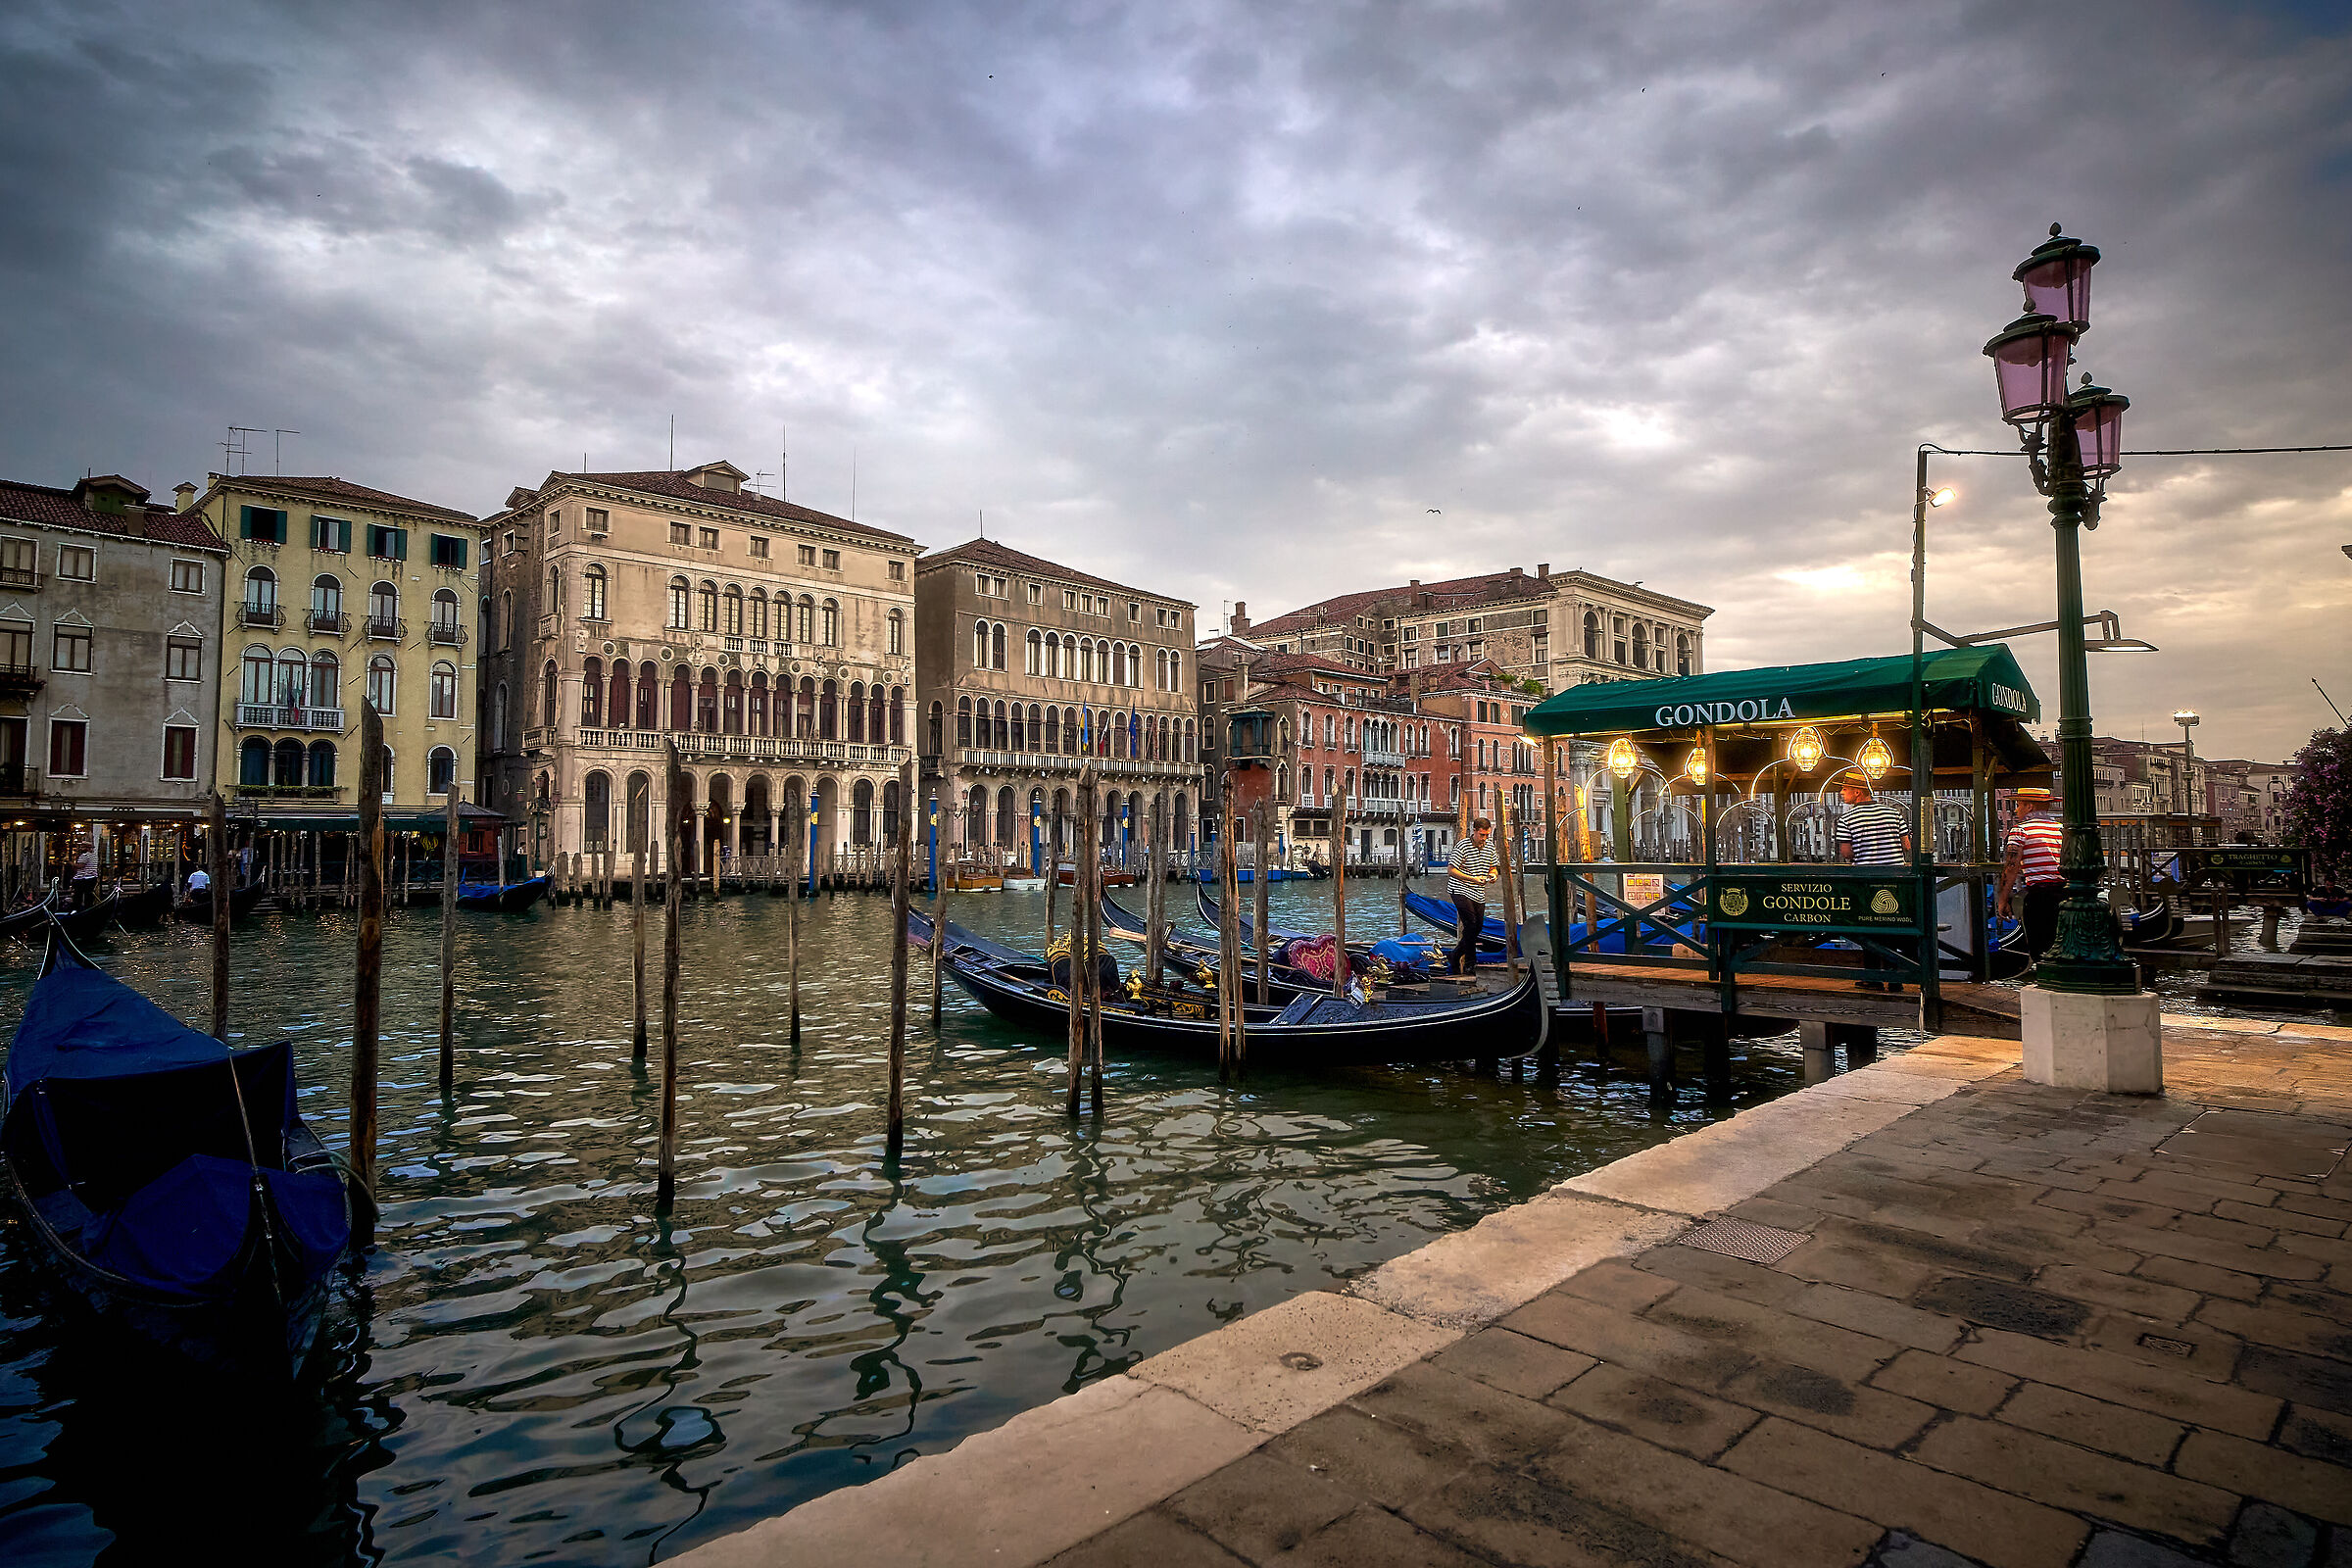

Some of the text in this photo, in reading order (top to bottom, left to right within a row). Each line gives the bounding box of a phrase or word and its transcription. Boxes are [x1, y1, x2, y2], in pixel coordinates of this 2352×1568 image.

[1991, 682, 2027, 713] GONDOLA
[1655, 697, 1795, 726] GONDOLA
[1781, 883, 1833, 893] SERVIZIO
[1763, 896, 1851, 910] GONDOLE
[1784, 913, 1832, 923] CARBON
